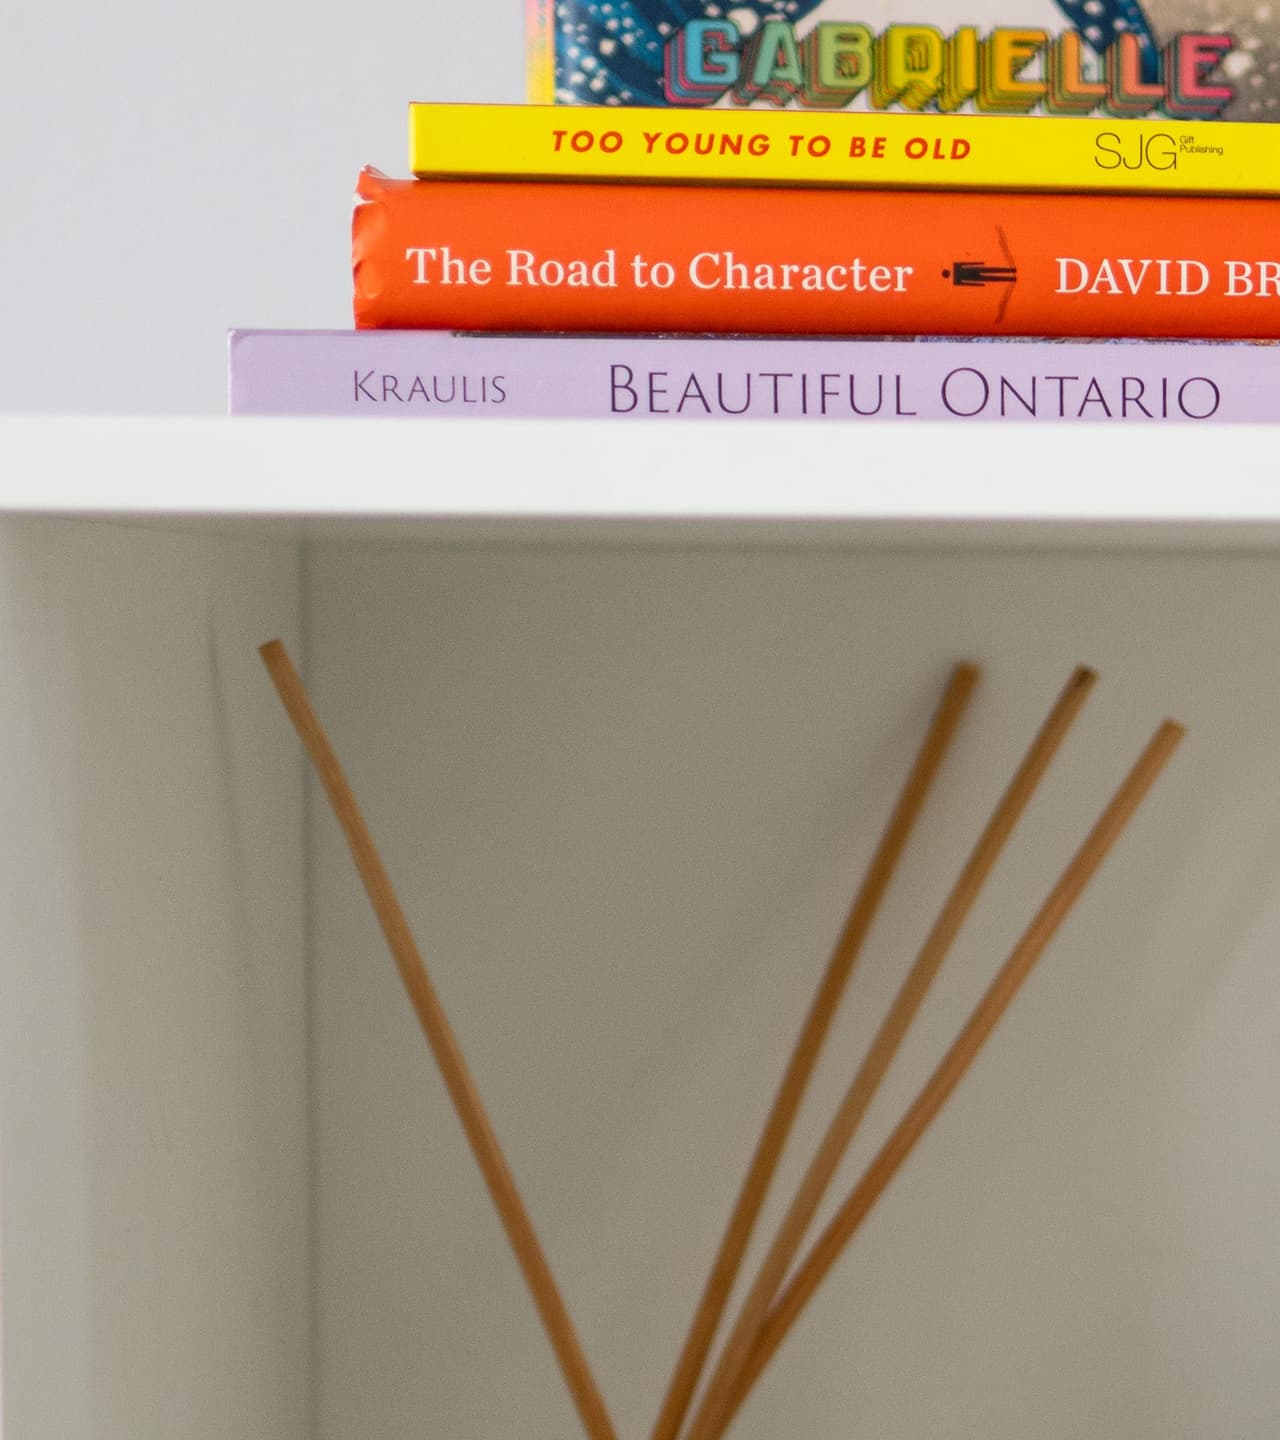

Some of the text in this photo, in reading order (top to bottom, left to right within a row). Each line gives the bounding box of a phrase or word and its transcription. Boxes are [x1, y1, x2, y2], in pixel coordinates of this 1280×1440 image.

[664, 20, 1235, 116] GABRIELLE
[551, 130, 971, 161] TOO YOUNG TO BE OLD
[1094, 132, 1177, 170] SJG
[1179, 135, 1195, 145] Gift
[1179, 144, 1224, 156] Publishing
[406, 249, 913, 292] The Road to Character
[1055, 258, 1210, 296] DAVID
[353, 370, 506, 404] KRAULIS
[609, 365, 1221, 419] BEAUTIFUL ONTARIO
